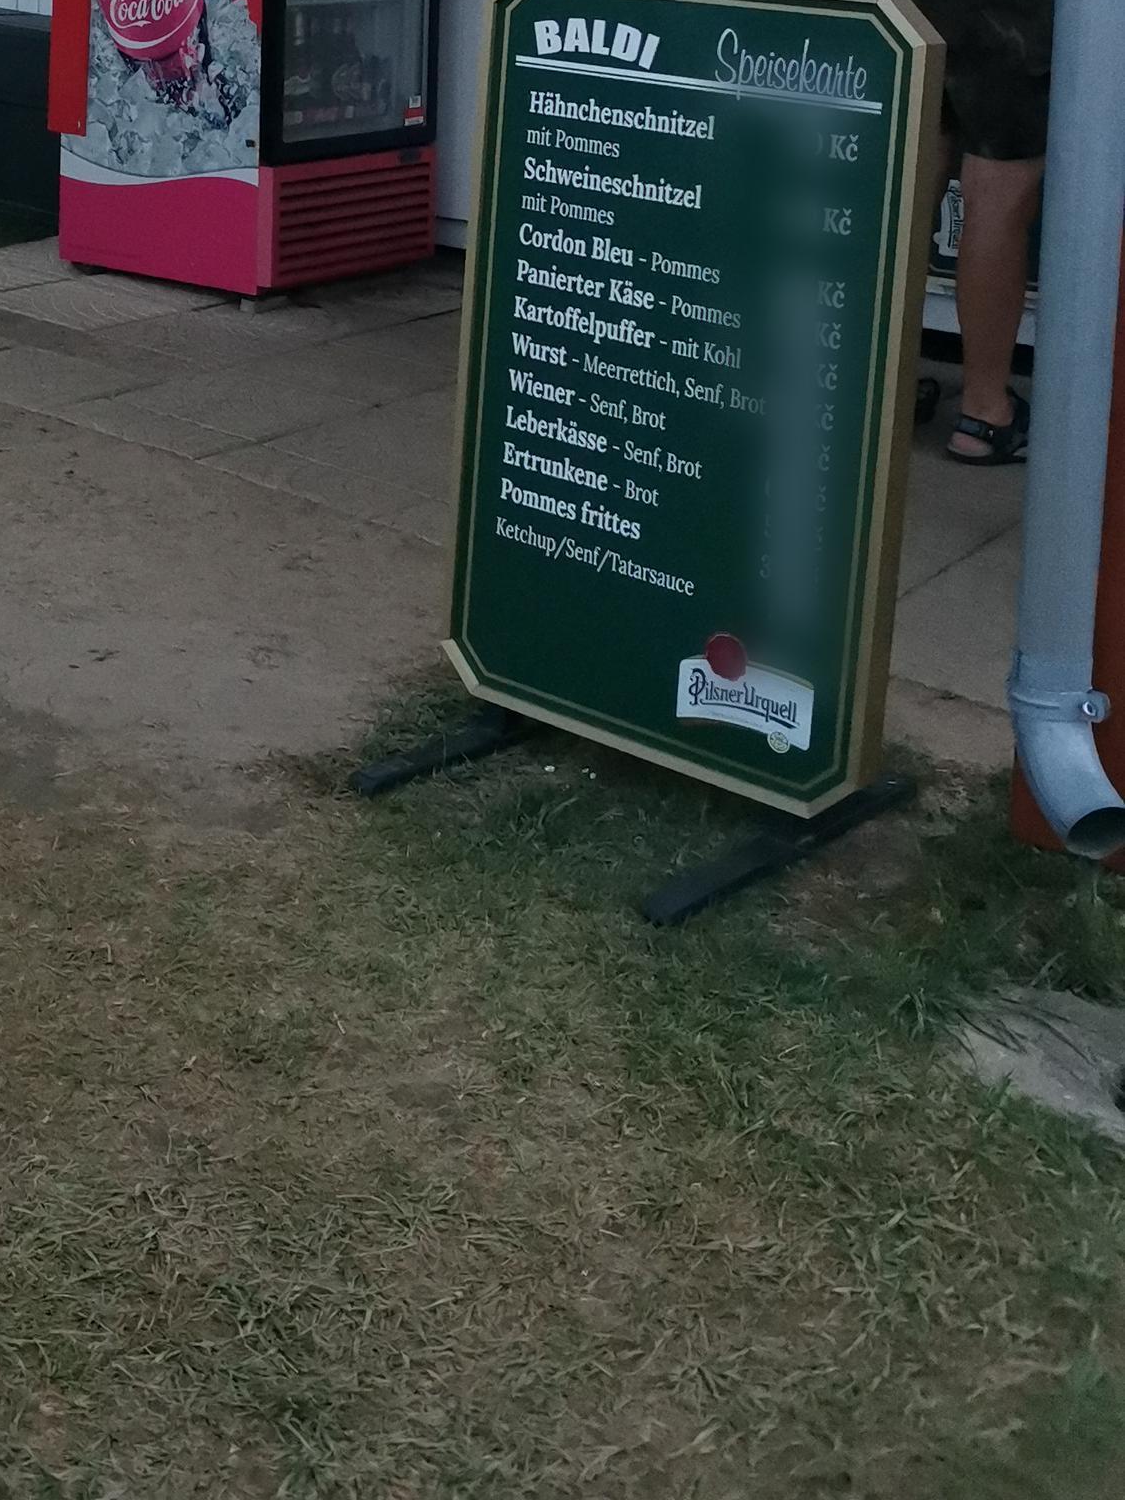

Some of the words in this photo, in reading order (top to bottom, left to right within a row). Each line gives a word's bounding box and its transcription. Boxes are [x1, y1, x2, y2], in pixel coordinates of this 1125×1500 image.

[534, 17, 661, 71] BALDI
[715, 27, 868, 101] Speisekarte
[526, 127, 553, 147] mit
[555, 129, 621, 159] Pommes
[528, 90, 715, 141] Hähnchenschnitzel
[828, 132, 860, 163] Kč
[521, 192, 547, 214] mit
[549, 195, 615, 227] Pommes
[523, 156, 702, 210] Schweineschnitzel
[822, 206, 852, 237] Kč
[519, 223, 587, 264] Cordon
[591, 236, 634, 268] Bleu
[651, 251, 721, 285] Pommes
[516, 259, 605, 299] Panierter
[608, 278, 655, 310] Käse
[670, 295, 742, 330] Pommes
[514, 296, 657, 350] Kartoffelpuffer
[672, 337, 700, 361] mit
[704, 340, 742, 370] Kohl
[508, 368, 576, 406] Wiener
[590, 393, 629, 424] Senf,
[631, 404, 667, 431] Brot
[511, 331, 568, 368] Wurst
[583, 352, 681, 398] Meerrettich,
[684, 378, 726, 411] Senf,
[730, 387, 767, 416] Brot
[502, 441, 609, 492] Ertrunkene
[624, 478, 660, 508] Brot
[506, 404, 608, 454] Leberkässe
[623, 441, 663, 471] Senf,
[666, 451, 703, 480] Brot
[500, 477, 577, 521] Pommes
[580, 501, 642, 540] frittes
[495, 515, 695, 597] Ketchup/Senf/Tatarsauce
[688, 667, 744, 707] Pilsner
[743, 682, 798, 723] Urquell
